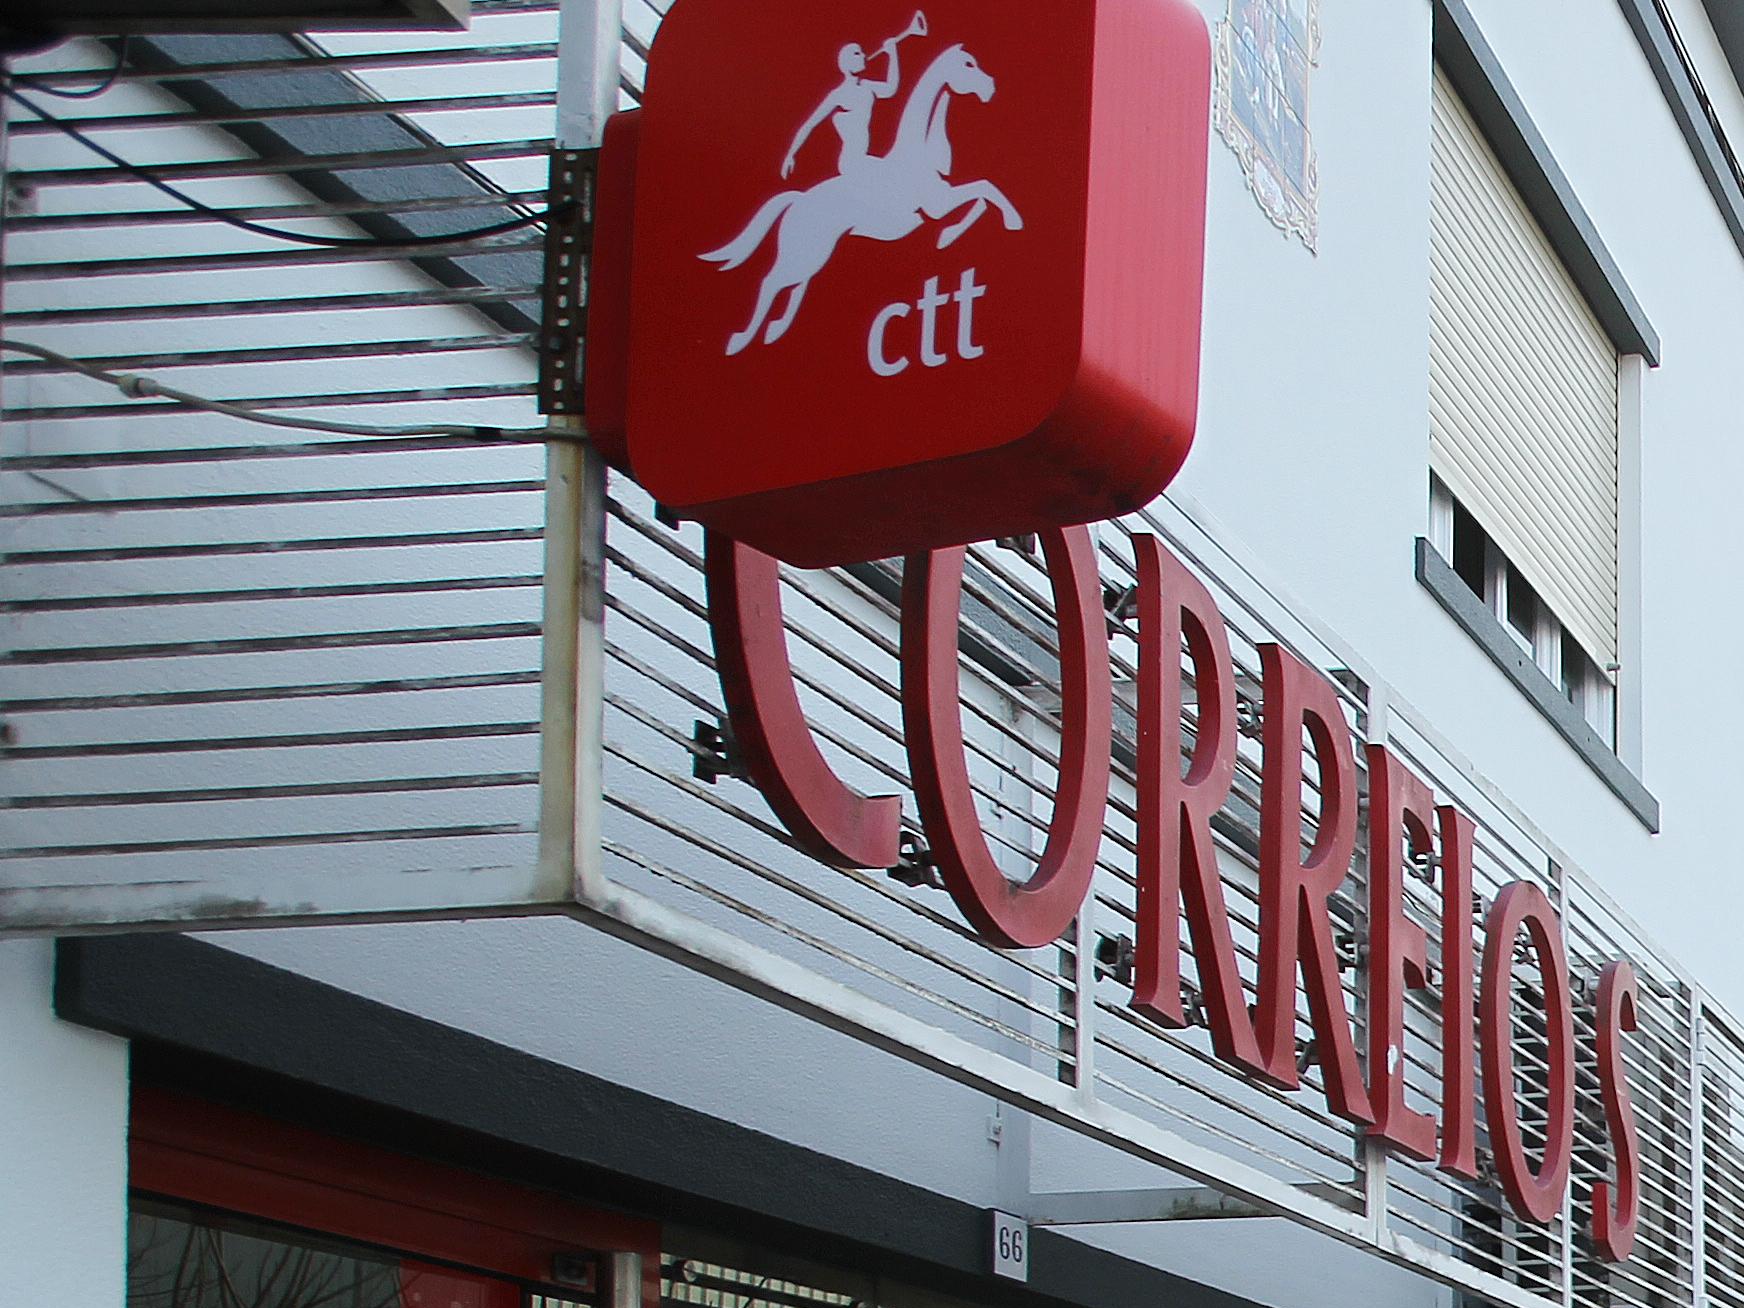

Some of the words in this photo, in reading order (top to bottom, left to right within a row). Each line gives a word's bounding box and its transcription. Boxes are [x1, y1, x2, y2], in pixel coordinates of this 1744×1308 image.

[866, 267, 987, 377] ctt
[703, 522, 1641, 1263] CORREIOS
[999, 1226, 1023, 1263] 66
